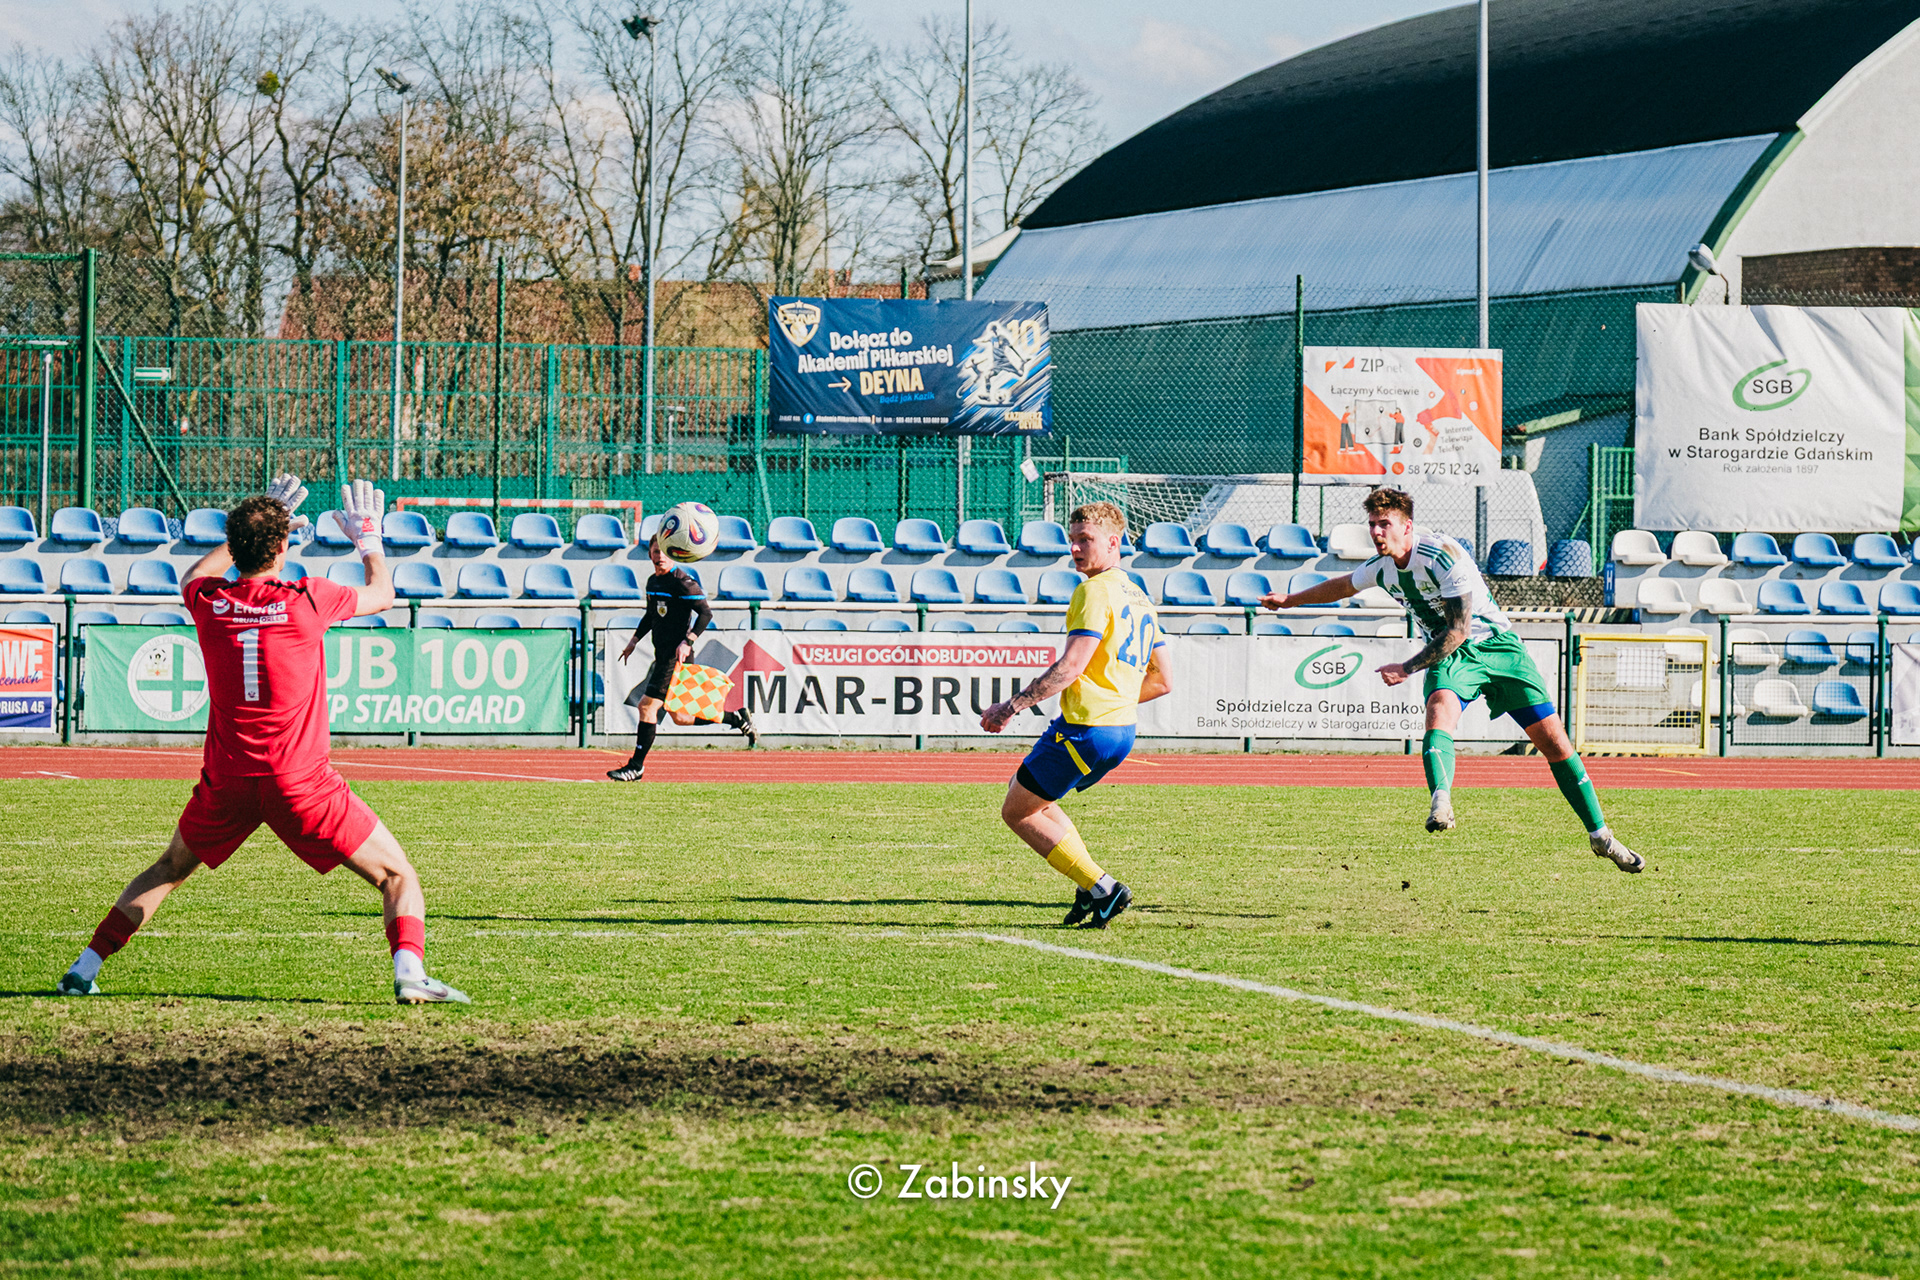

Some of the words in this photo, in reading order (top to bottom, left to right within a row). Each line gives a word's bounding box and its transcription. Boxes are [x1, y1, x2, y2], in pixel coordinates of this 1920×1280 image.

[829, 329, 887, 350] Dołącz
[889, 327, 913, 345] do
[798, 350, 869, 374] Akademii
[870, 344, 954, 368] Piłkarskiej
[859, 367, 924, 396] DEYNA
[1752, 379, 1793, 394] SGB
[1331, 385, 1374, 396] Łączymy
[1377, 385, 1420, 396] Kociewie
[1445, 425, 1474, 434] Internet
[1699, 428, 1740, 441] Bank
[1745, 428, 1845, 445] Spółdzielczy
[1438, 443, 1465, 453] Telefon
[1668, 448, 1681, 458] w
[1686, 445, 1789, 462] Starogardzie
[1794, 446, 1873, 461] Gdańskim
[1408, 465, 1420, 475] 58
[1423, 463, 1446, 475] 775
[1449, 462, 1461, 475] 12
[1463, 462, 1480, 475] 34
[1723, 463, 1743, 473] Rok
[1745, 463, 1793, 474] założenia
[1796, 464, 1819, 474] 1897
[234, 600, 287, 615] Energa
[260, 614, 286, 623] ORLEN
[1116, 604, 1155, 667] 20
[0, 640, 43, 680] WE
[326, 635, 398, 690] UB
[420, 638, 530, 691] 100
[801, 647, 863, 663] USŁUGI
[865, 645, 1050, 665] OGÓLNOBUDOWLANE
[236, 628, 260, 701] 1
[1311, 662, 1346, 675] SGB
[747, 674, 1045, 716] MAR-BRUK
[0, 700, 29, 714] RUSA
[30, 700, 45, 714] 45
[326, 694, 349, 724] P
[353, 694, 526, 725] STAROGARD
[1216, 699, 1313, 714] Spółdzielcza
[1318, 700, 1365, 715] Grupa
[1197, 716, 1228, 728] Bank
[1231, 717, 1304, 730] Spółdzielczy
[1307, 719, 1318, 729] w
[1321, 718, 1396, 731] Starogardzie
